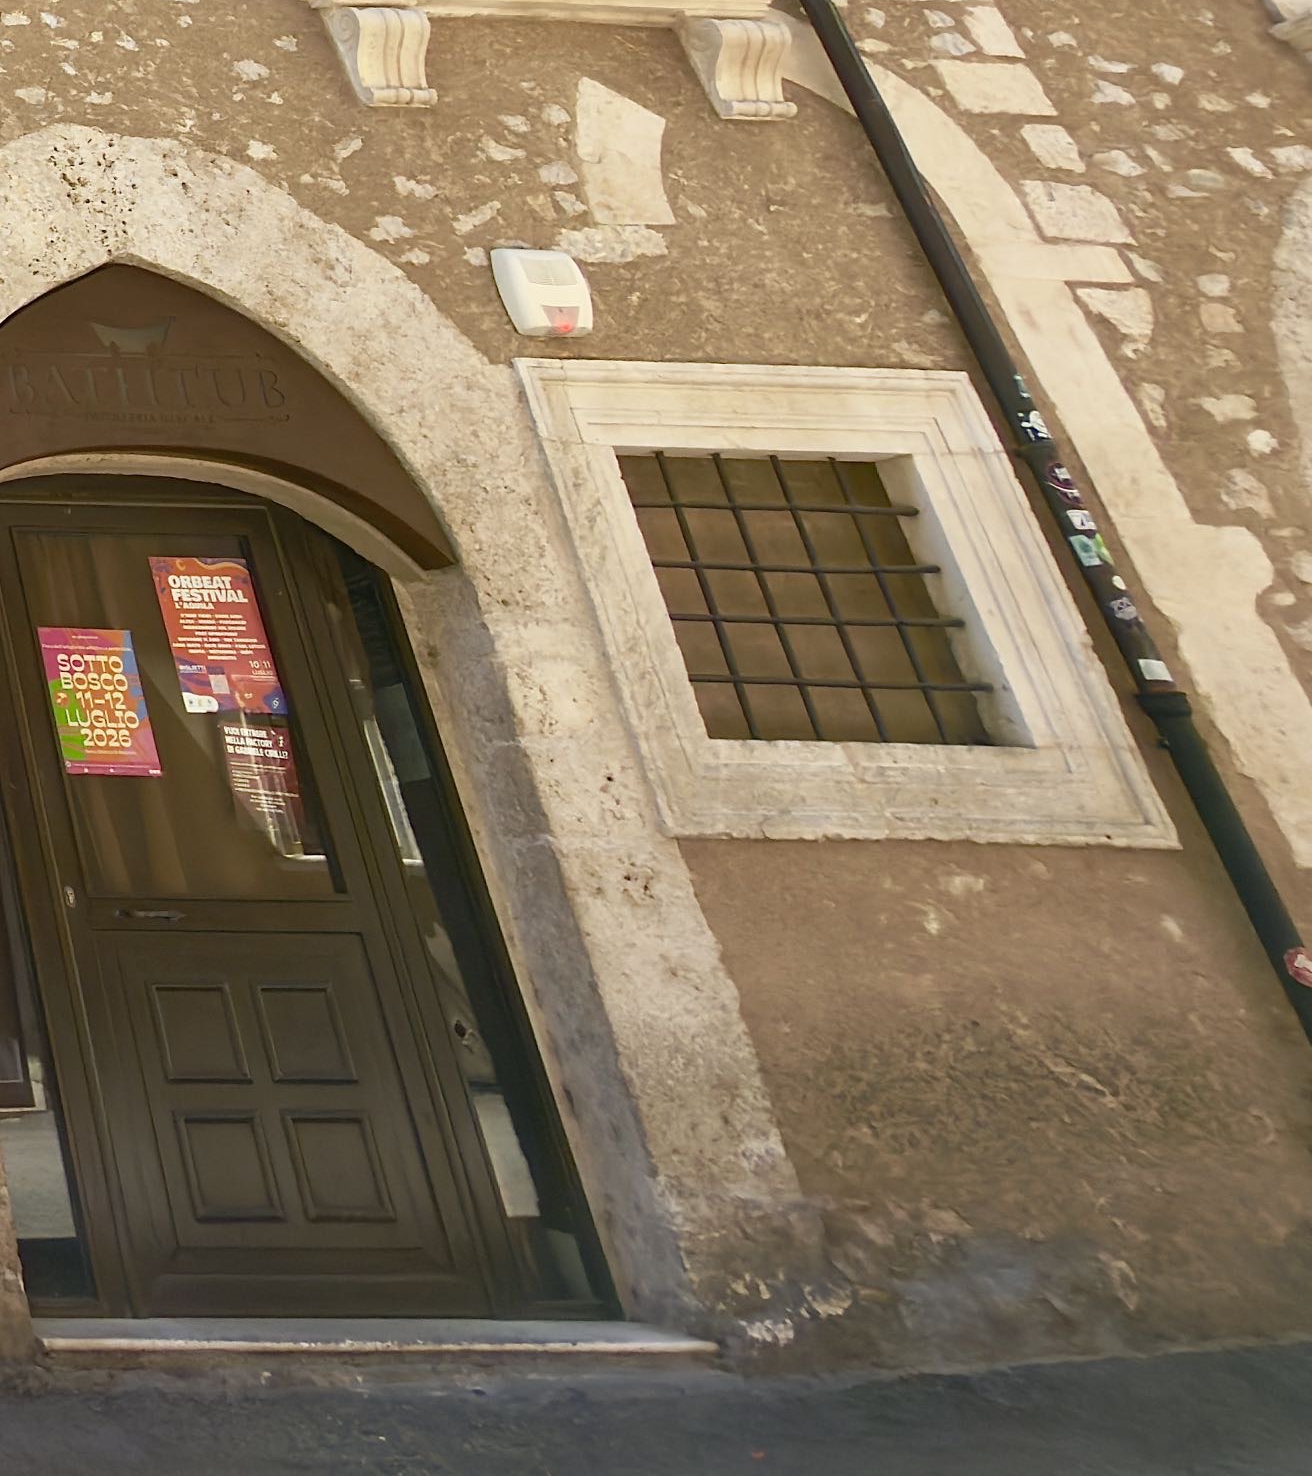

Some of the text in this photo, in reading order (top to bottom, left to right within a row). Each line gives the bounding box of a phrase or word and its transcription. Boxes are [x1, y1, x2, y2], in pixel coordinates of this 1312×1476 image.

[168, 575, 232, 589] ORBEAT
[171, 589, 248, 603] FESTIVAL
[57, 654, 123, 673] SOTTO
[60, 672, 128, 691] BOSCO
[76, 691, 126, 710] 11-12
[65, 709, 139, 729] LUGLIO
[80, 728, 132, 747] 2026
